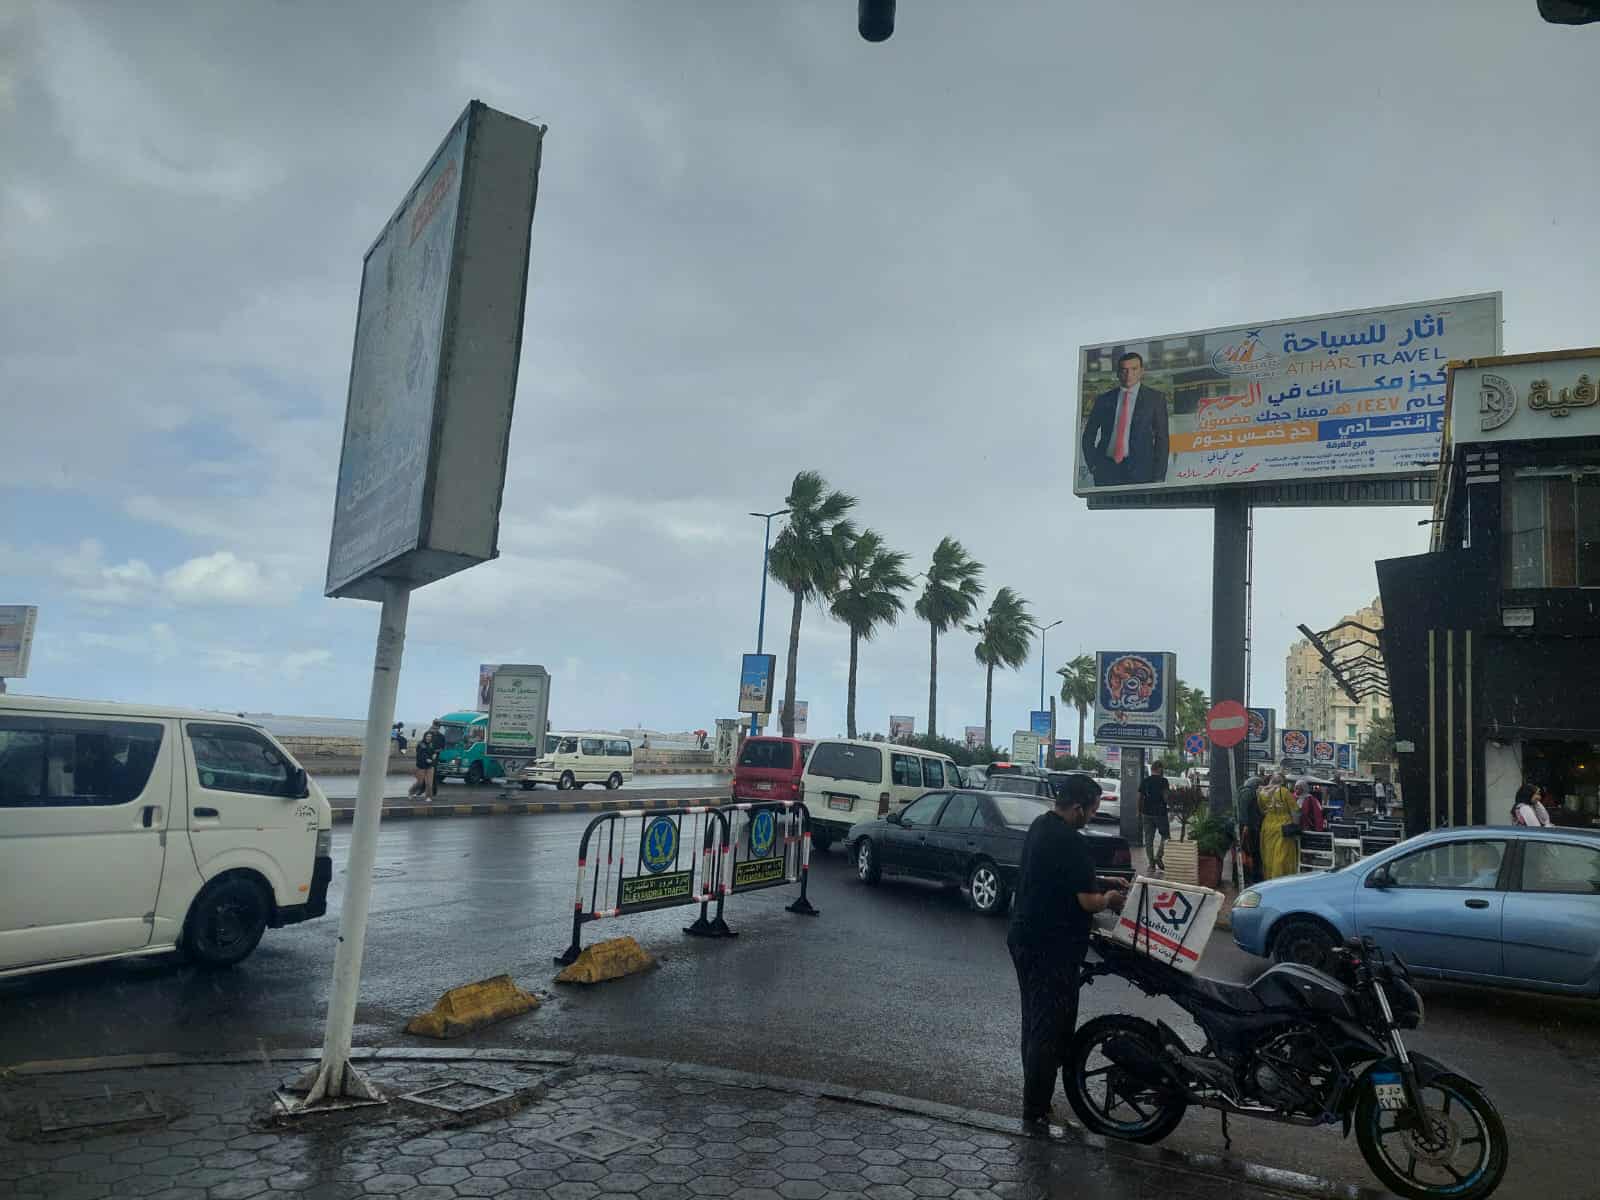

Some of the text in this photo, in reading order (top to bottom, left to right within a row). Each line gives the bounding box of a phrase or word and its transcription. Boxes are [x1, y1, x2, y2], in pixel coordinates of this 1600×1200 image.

[1283, 324, 1386, 355] للسياحة
[1286, 356, 1352, 376] ATHAR
[1357, 347, 1448, 369] TRAVEL
[1267, 383, 1301, 407] في
[1256, 409, 1291, 423] حجك
[1296, 406, 1329, 419] معنا
[1290, 425, 1312, 440] حج
